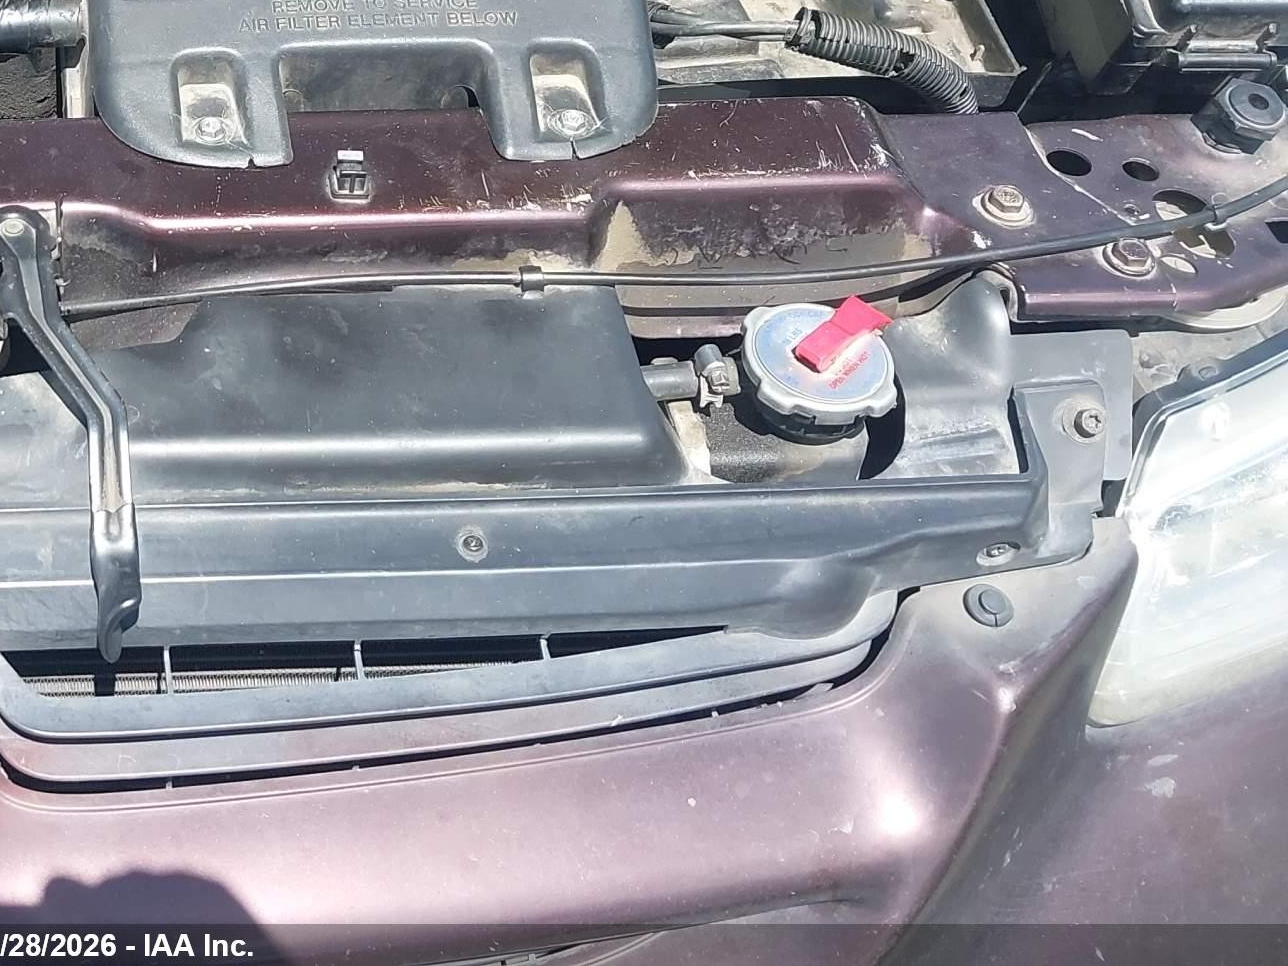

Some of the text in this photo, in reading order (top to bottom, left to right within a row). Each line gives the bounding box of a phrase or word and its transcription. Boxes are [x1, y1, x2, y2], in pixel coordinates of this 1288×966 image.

[239, 10, 518, 33] AIR FILTER ELEMENT BELOW
